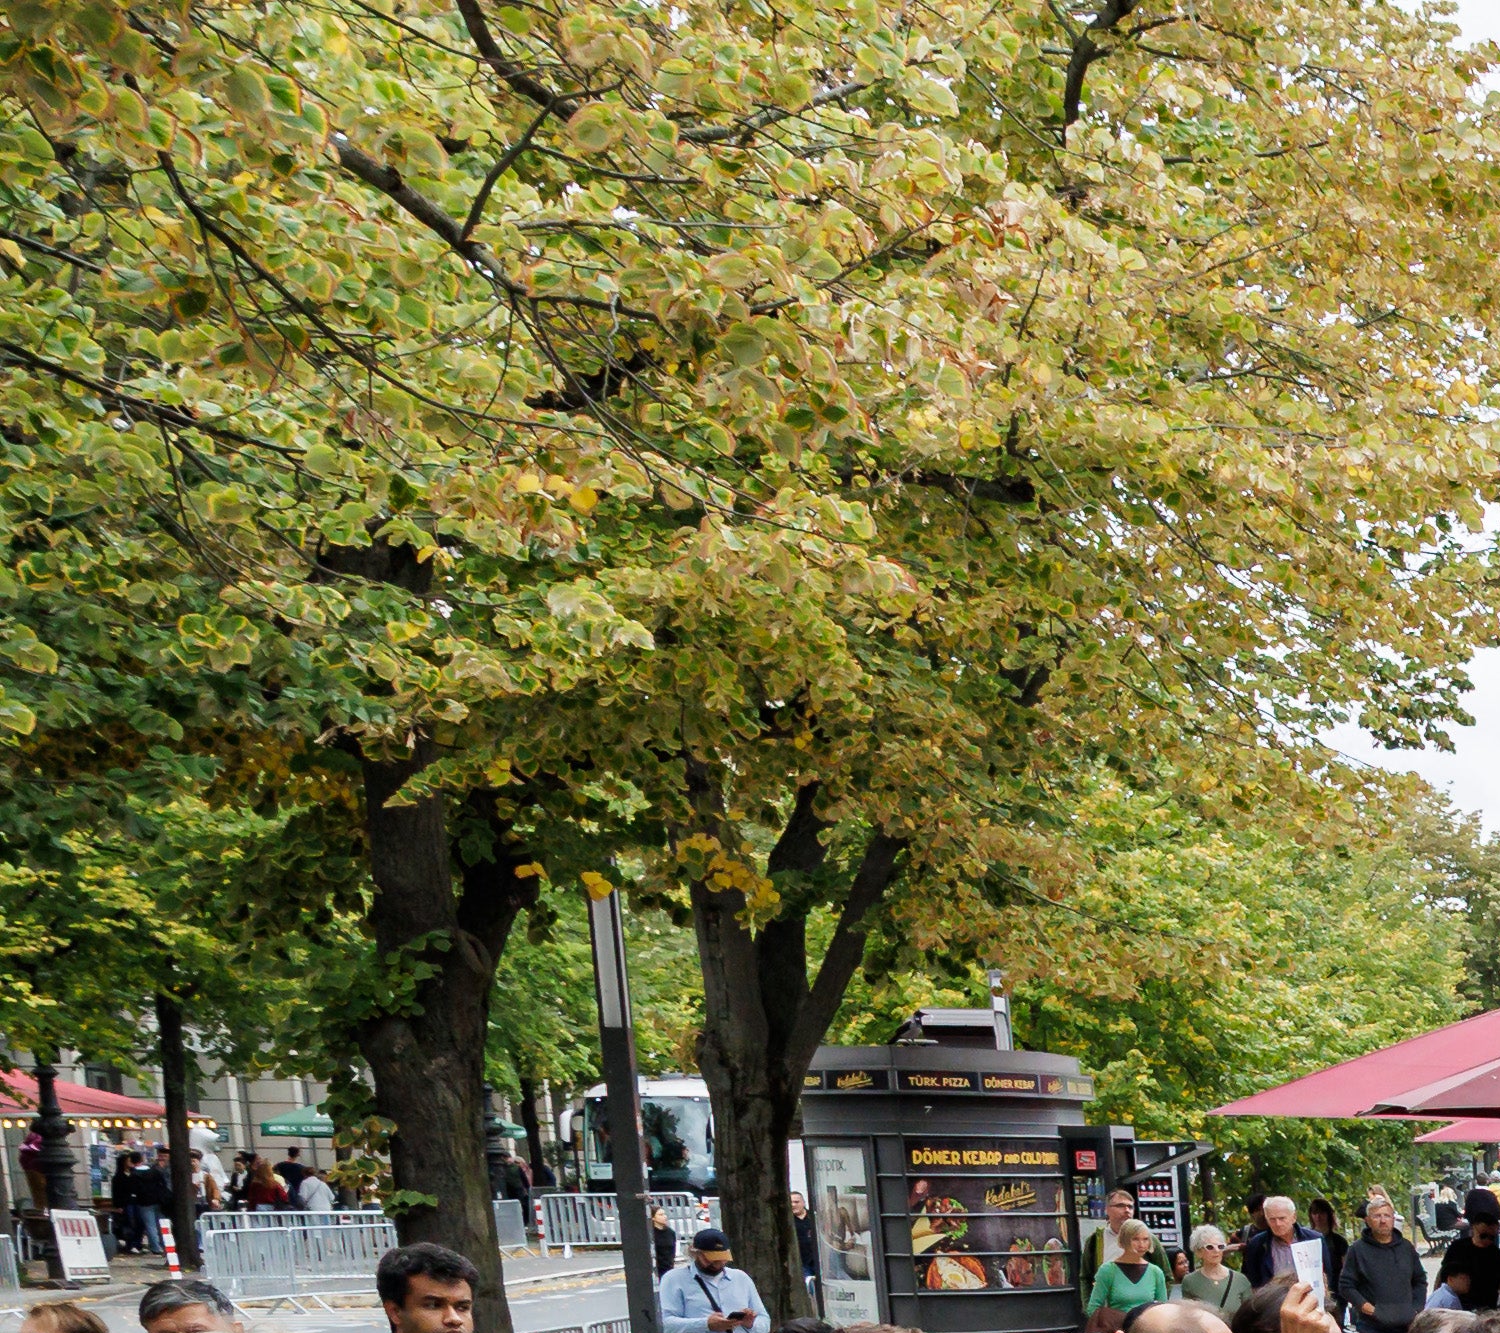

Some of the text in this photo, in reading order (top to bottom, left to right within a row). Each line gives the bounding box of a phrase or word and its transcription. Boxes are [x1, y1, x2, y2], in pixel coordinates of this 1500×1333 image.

[942, 1077, 971, 1088] PIZZA
[984, 1076, 1012, 1089] DÖNER
[912, 1147, 961, 1166] DÖNER
[963, 1150, 1002, 1166] KEBAP
